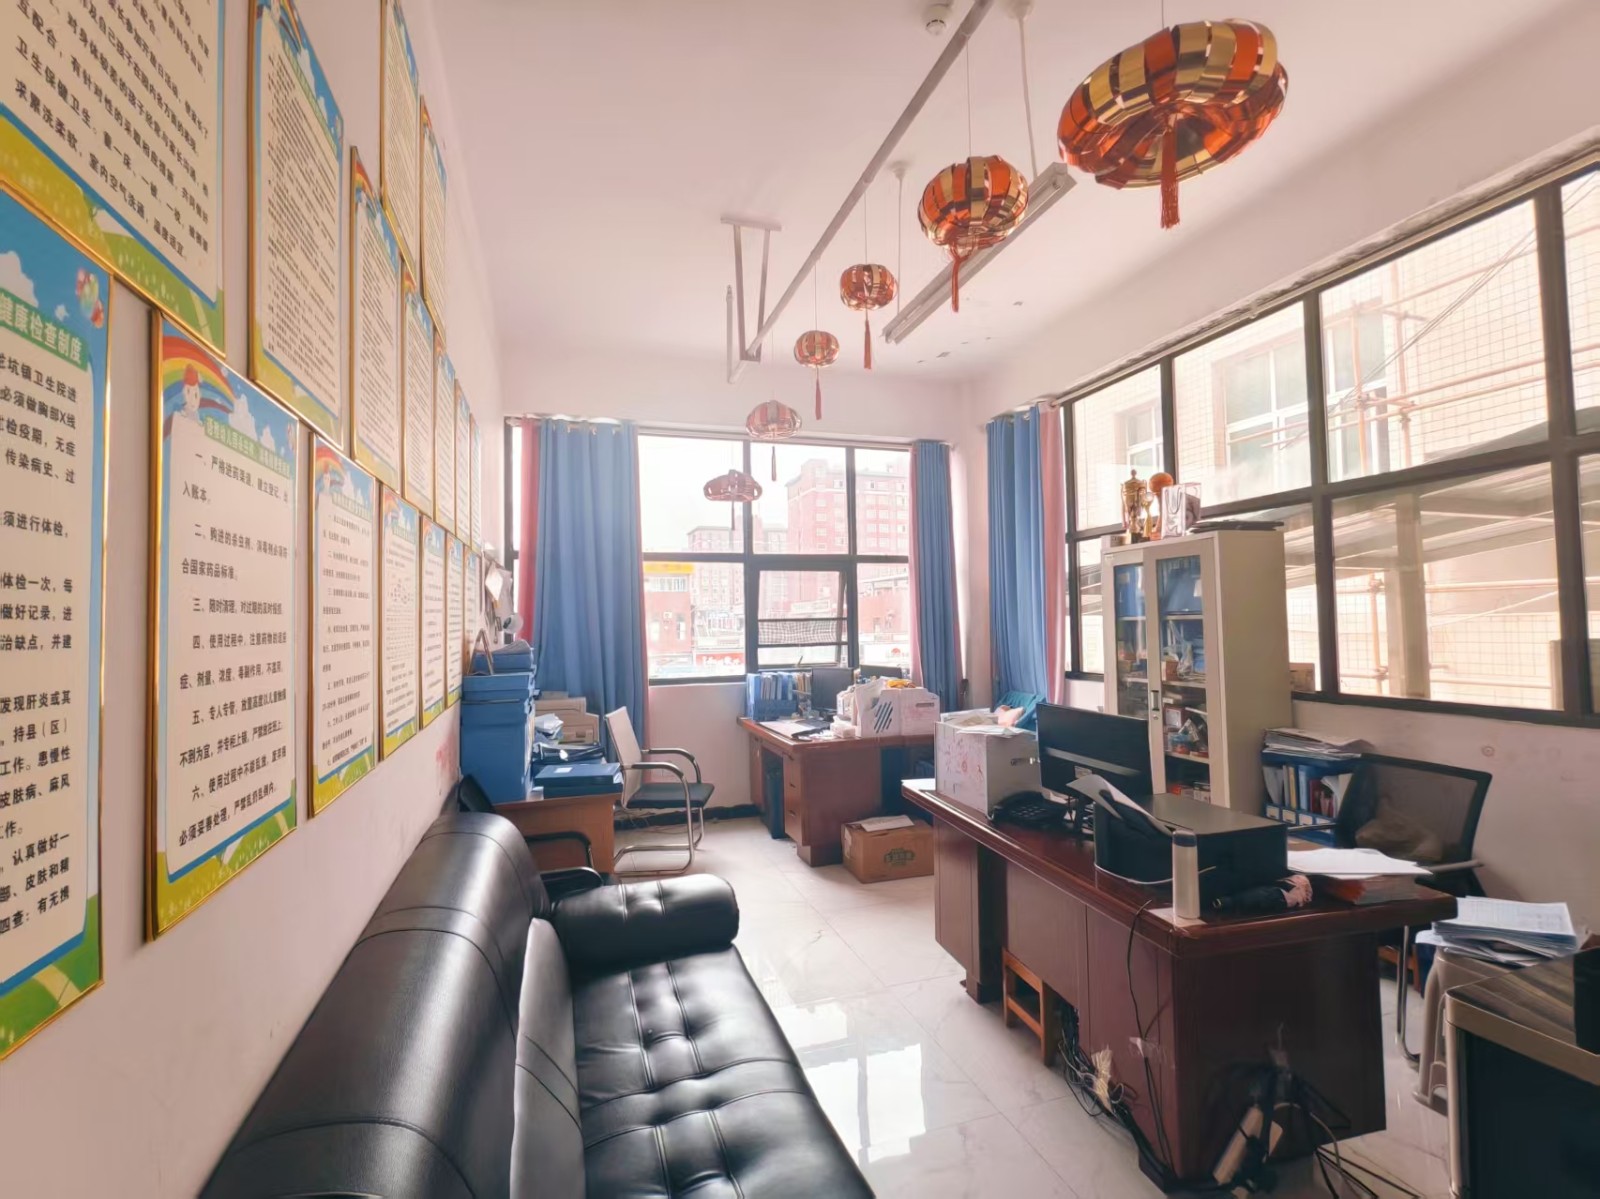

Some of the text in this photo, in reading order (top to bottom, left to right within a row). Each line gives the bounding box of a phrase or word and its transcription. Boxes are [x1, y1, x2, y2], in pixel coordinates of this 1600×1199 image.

[0, 510, 69, 538] 须进行体检，
[0, 572, 73, 593] 体检一次，每
[0, 603, 73, 621] 做好记录，进
[0, 689, 71, 714] 发现肝炎或其
